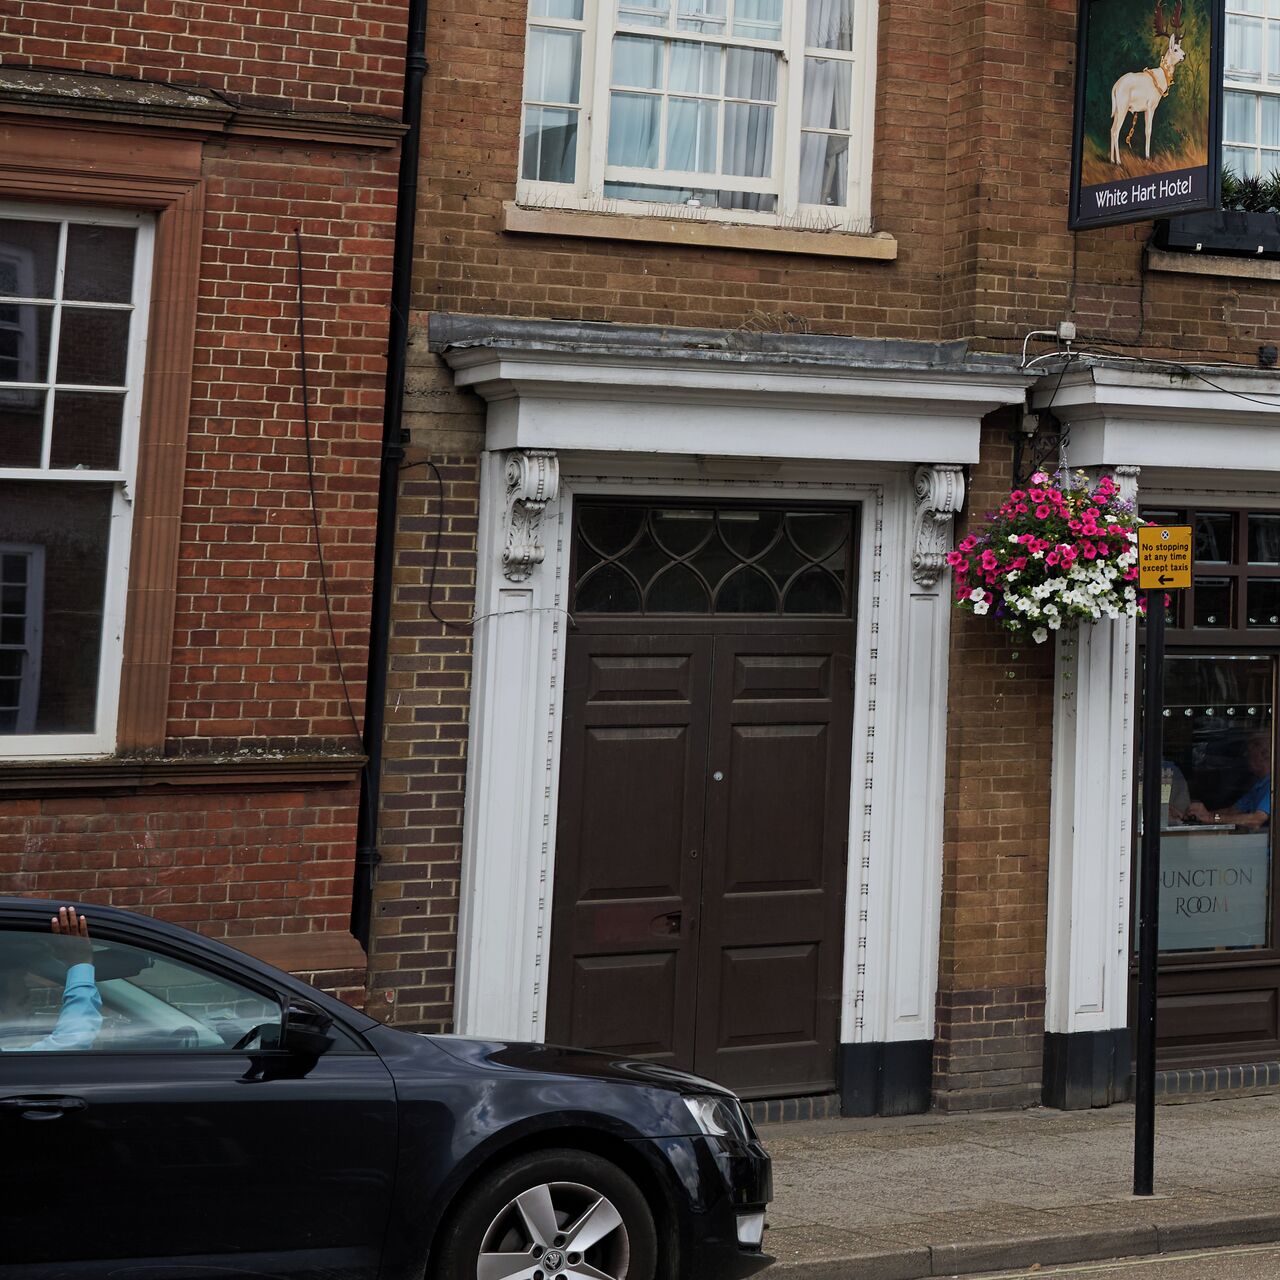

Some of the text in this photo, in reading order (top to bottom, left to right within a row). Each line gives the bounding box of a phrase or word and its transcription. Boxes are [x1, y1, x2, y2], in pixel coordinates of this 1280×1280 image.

[1095, 175, 1192, 208] White Hart Hotel
[1142, 543, 1189, 552] No stopping
[1143, 552, 1187, 562] at any time
[1142, 563, 1188, 572] except taxis
[1160, 868, 1253, 889] UNCTION
[1176, 895, 1229, 918] ROOM
